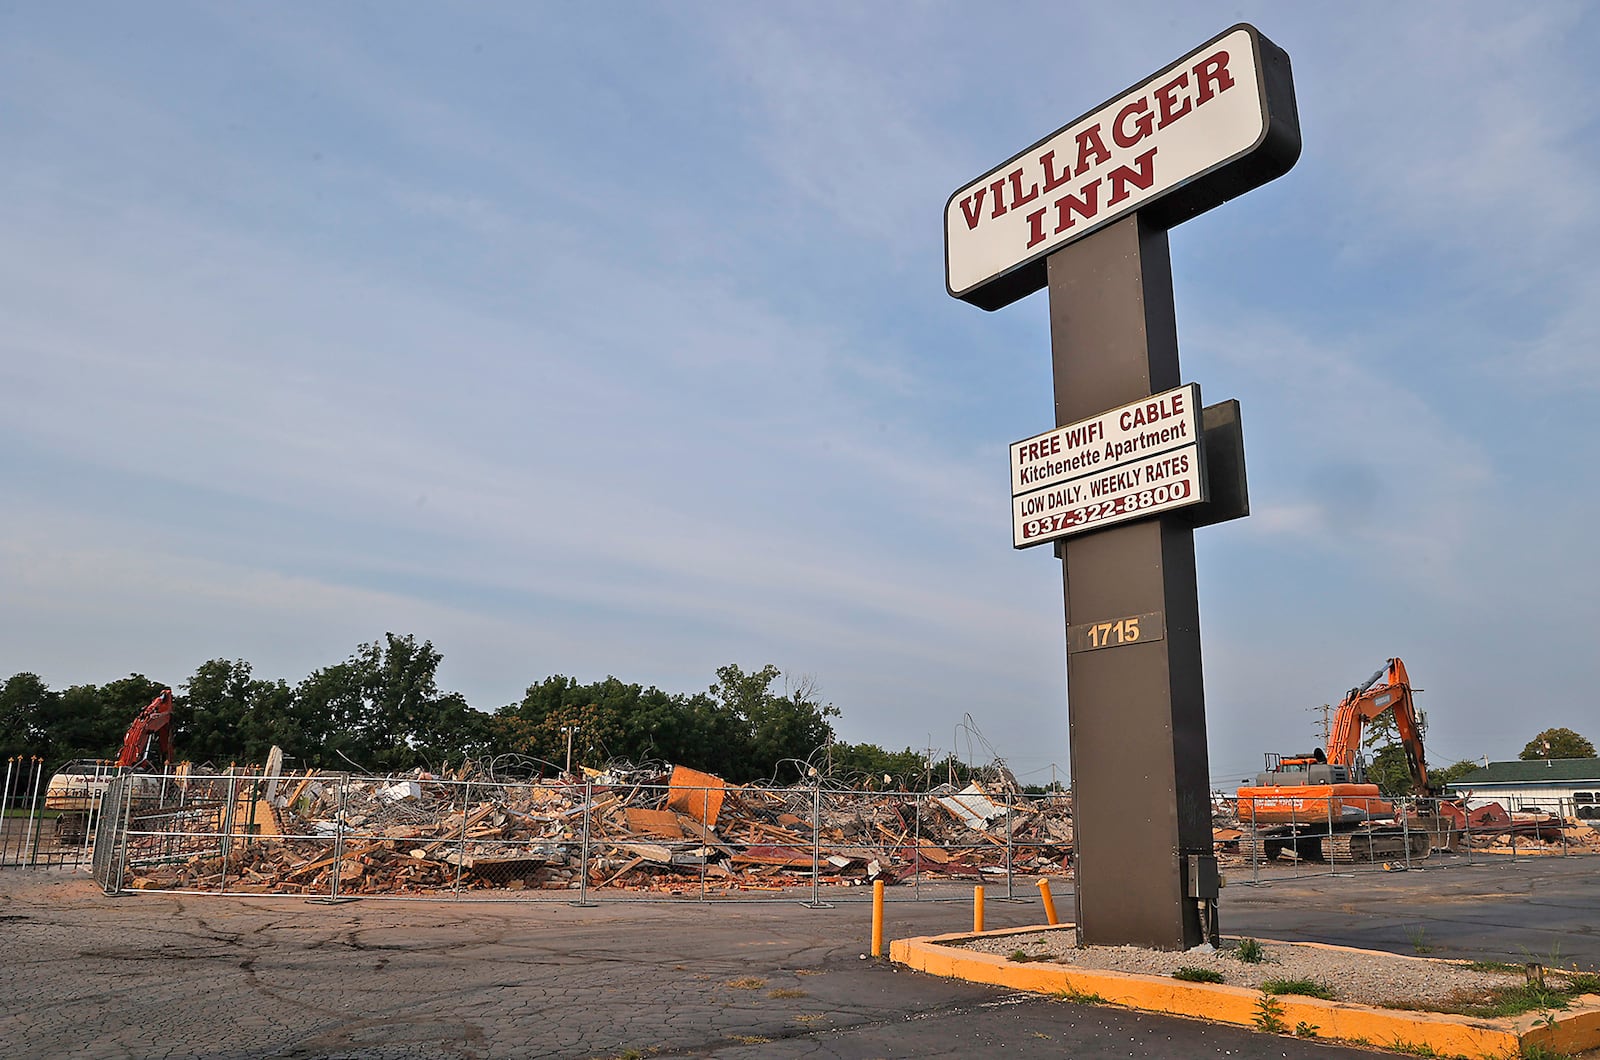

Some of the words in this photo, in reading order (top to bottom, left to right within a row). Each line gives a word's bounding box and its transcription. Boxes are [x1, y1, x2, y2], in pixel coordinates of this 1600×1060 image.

[959, 50, 1234, 230] VILLAGER
[1026, 147, 1158, 249] INN
[1019, 435, 1060, 464] FREE
[1066, 421, 1104, 449] WIFI
[1120, 394, 1184, 431] CABLE
[1020, 451, 1100, 485] Kitchenette
[1104, 419, 1187, 460] Apartment
[1021, 496, 1045, 517] LOW
[1090, 468, 1141, 498] WEEKLY
[1146, 455, 1189, 482] RATES
[1027, 481, 1185, 537] 937-322-8800
[1087, 618, 1140, 647] 1715
